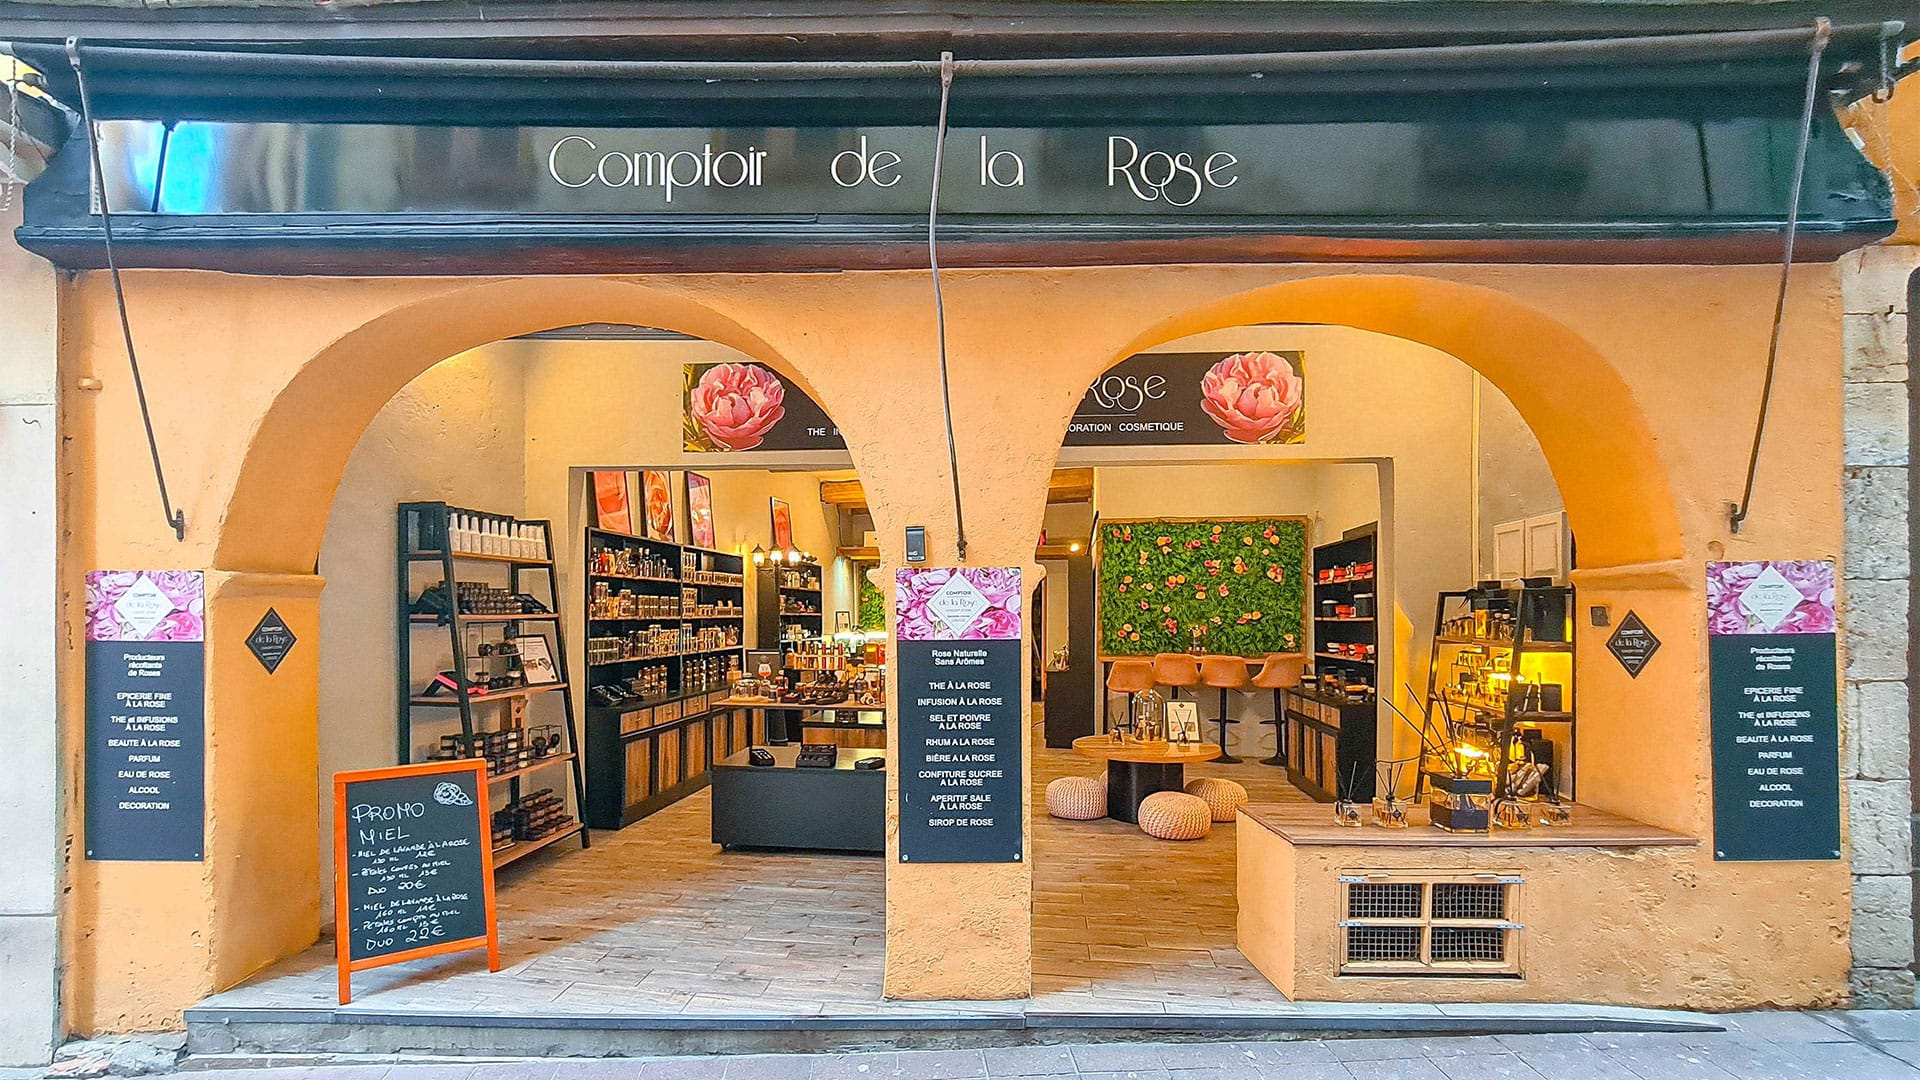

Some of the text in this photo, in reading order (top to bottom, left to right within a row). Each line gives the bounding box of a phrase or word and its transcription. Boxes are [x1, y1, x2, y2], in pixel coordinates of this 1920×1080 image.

[549, 136, 1239, 206] Comptoir de la Rose
[807, 428, 826, 436] THE
[1068, 423, 1184, 433] ORATION COSMETIQUE
[932, 650, 988, 658] Rose Naturelle
[934, 658, 984, 666] Sans Arômes
[928, 682, 946, 690] THE
[956, 682, 966, 690] LA
[968, 682, 990, 690] ROSE
[1784, 686, 1804, 696] FINE
[154, 692, 172, 700] FINE
[1772, 694, 1796, 702] ROSE
[918, 698, 958, 706] INFUSION
[966, 698, 978, 706] LA
[978, 698, 1002, 706] ROSE
[946, 714, 958, 722] ET
[960, 714, 990, 722] POIVRE
[1766, 710, 1810, 718] INFUSIONS
[110, 716, 126, 724] THE
[136, 716, 178, 724] INFUSIONS
[1774, 718, 1798, 726] ROSE
[132, 724, 142, 732] LA
[144, 724, 166, 732] ROSE
[958, 722, 982, 730] ROSE
[926, 738, 950, 746] RHUM
[1736, 736, 1768, 744] BEAUTE
[1790, 734, 1814, 742] ROSE
[158, 740, 180, 748] ROSE
[128, 754, 160, 762] PARFUM
[972, 754, 996, 762] ROSE
[136, 770, 148, 778] DE
[148, 770, 170, 778] ROSE
[918, 770, 966, 778] CONFITURE
[1748, 768, 1766, 776] EAU
[1766, 768, 1778, 776] DE
[948, 778, 958, 786] LA
[960, 778, 984, 786] ROSE
[1758, 784, 1792, 792] ALCOOL
[930, 794, 968, 802] APERITIF
[118, 802, 170, 810] DECORATION
[946, 802, 958, 810] LA
[958, 802, 984, 810] ROSE
[1750, 800, 1804, 808] DECORATION
[352, 802, 424, 823] PROMO
[928, 818, 954, 826] SIROP
[956, 818, 968, 826] DE
[360, 826, 410, 844] MIEL
[366, 926, 446, 951] DUO 22€
